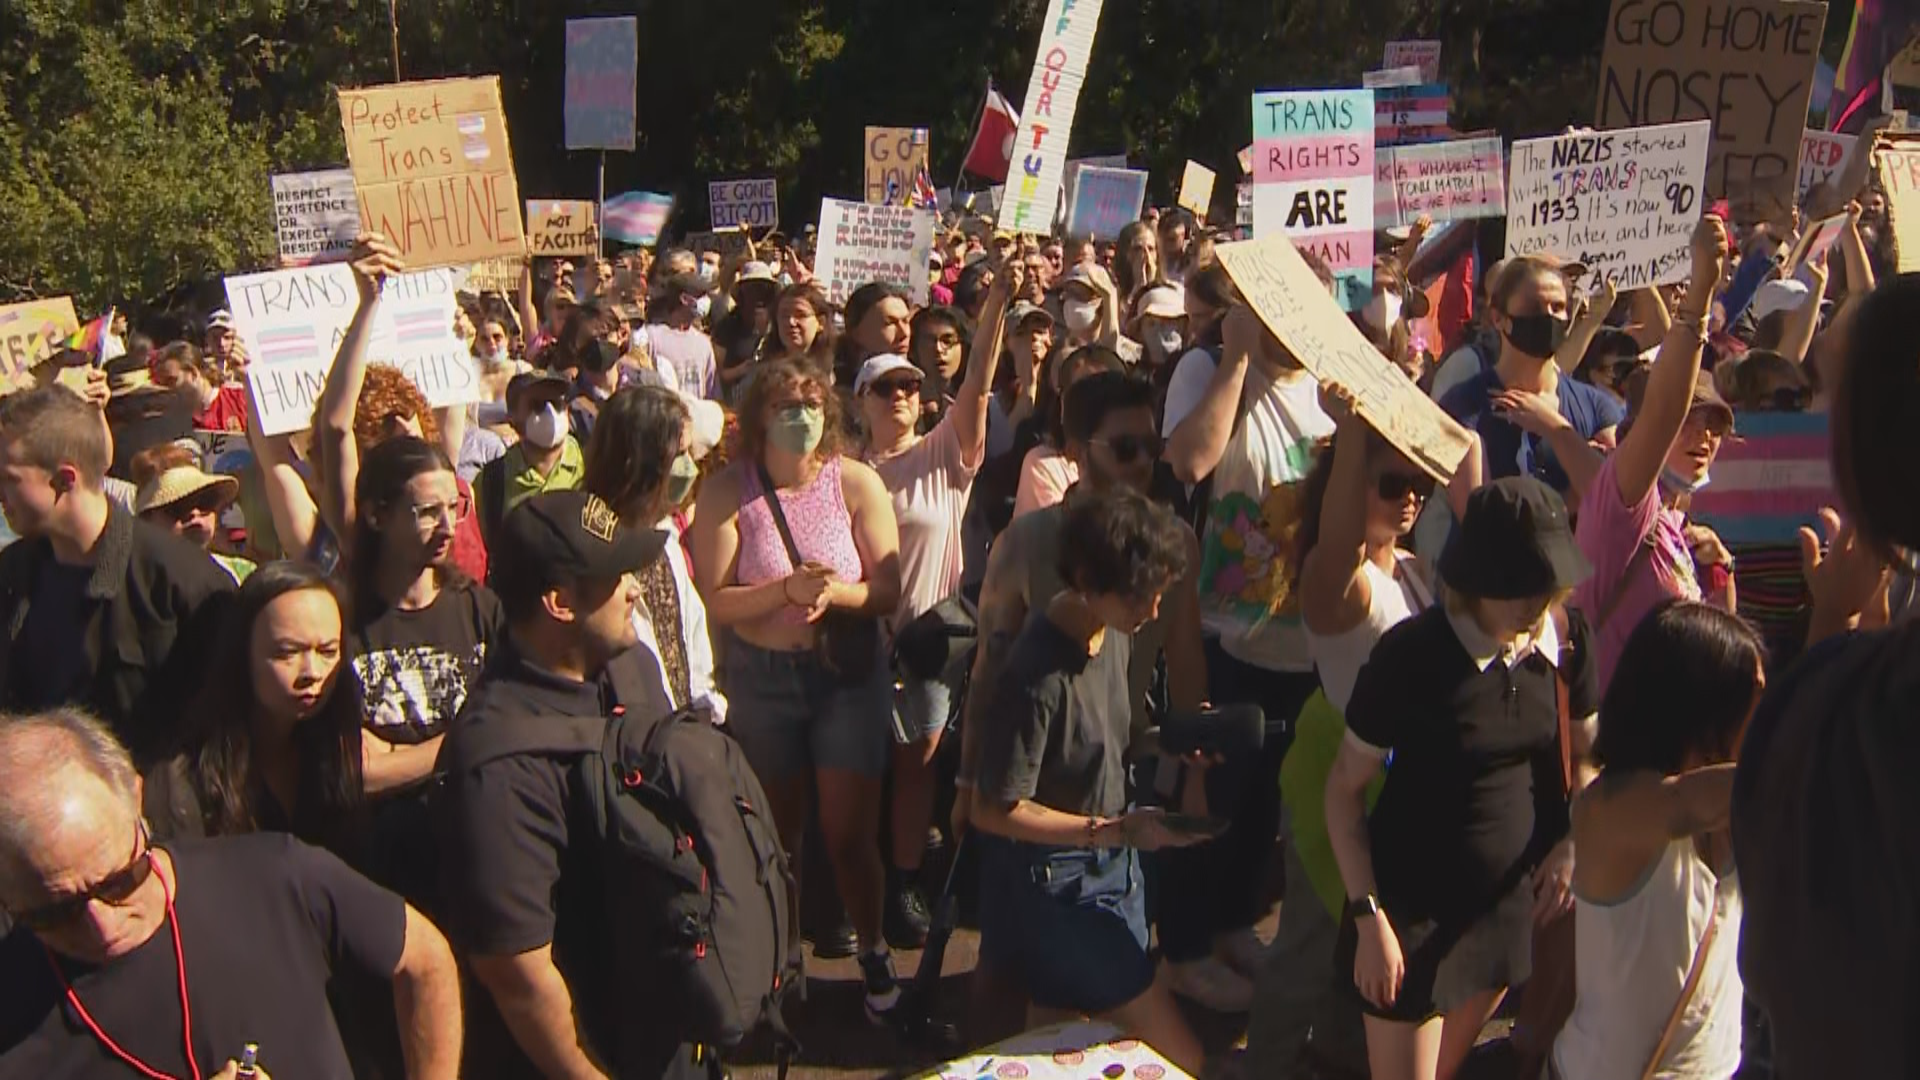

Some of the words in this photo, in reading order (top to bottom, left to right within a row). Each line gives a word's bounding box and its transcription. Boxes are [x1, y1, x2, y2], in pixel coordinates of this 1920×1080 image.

[1614, 2, 1685, 47] GO
[1701, 6, 1818, 55] HOME
[1034, 47, 1068, 117] OUR
[351, 93, 443, 135] Protect
[1265, 99, 1354, 132] TRANS
[1601, 65, 1803, 144] NOSEY
[370, 137, 452, 178] Trans
[870, 133, 913, 162] GO
[1269, 143, 1360, 172] RIGHTS
[1518, 143, 1546, 174] The
[1551, 137, 1615, 169] NAZIS
[1620, 131, 1687, 157] started
[1802, 137, 1843, 166] RED
[276, 187, 331, 202] RESPECT
[711, 185, 728, 202] BE
[733, 181, 774, 200] GONE
[866, 164, 919, 204] HOM
[1552, 160, 1638, 198] TRANS
[1639, 160, 1688, 198] people
[278, 199, 346, 216] EXISTENCE
[279, 217, 298, 228] OR
[363, 174, 518, 256] WAHINE
[835, 201, 914, 229] TRANS
[1284, 189, 1347, 228] ARE
[1511, 213, 1526, 230] in
[1587, 194, 1619, 222] It's
[1625, 199, 1660, 216] now
[1666, 183, 1695, 215] 90
[281, 227, 328, 241] EXPECT
[282, 239, 353, 254] RESISTANC
[836, 223, 915, 250] RIGHTS
[1510, 233, 1560, 256] years
[1616, 219, 1650, 241] and
[1300, 241, 1351, 263] MAN
[834, 257, 910, 284] HUMAN
[236, 272, 347, 318] TRANS
[255, 368, 326, 416] HUM
[396, 351, 472, 394] GHTS
